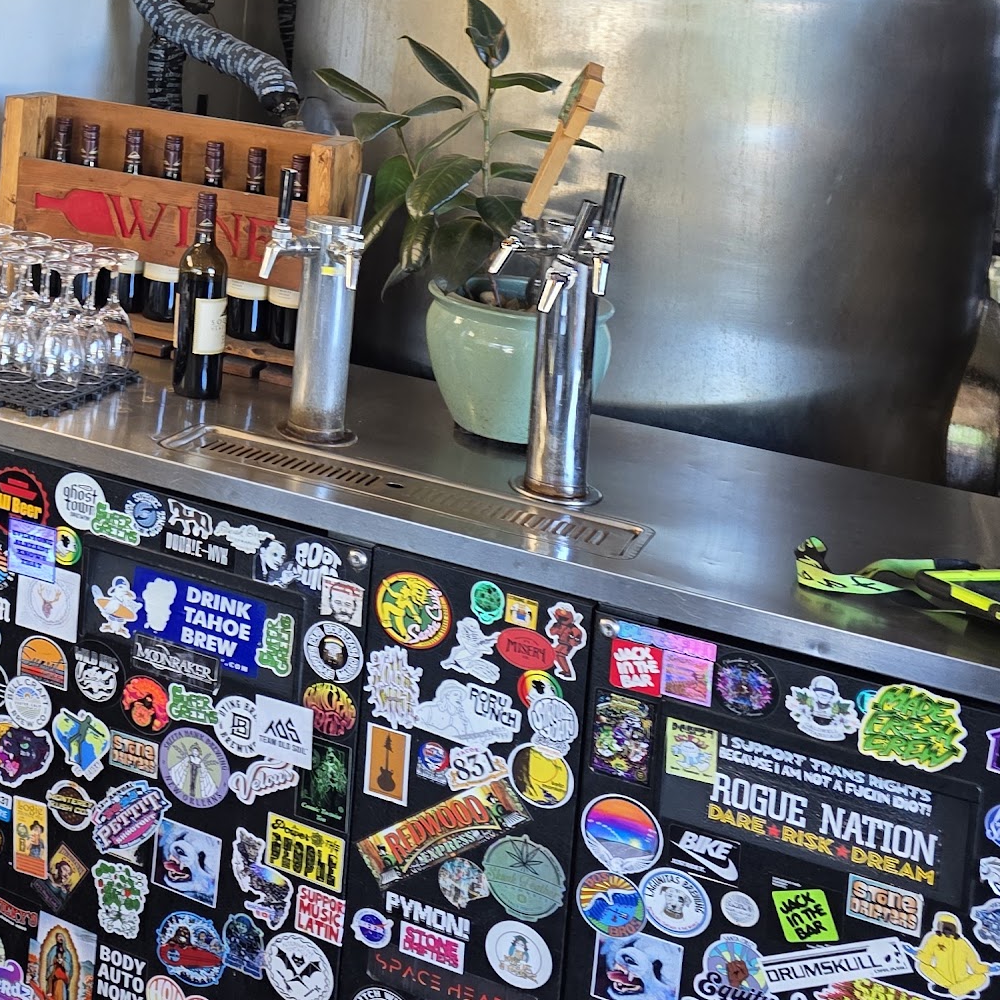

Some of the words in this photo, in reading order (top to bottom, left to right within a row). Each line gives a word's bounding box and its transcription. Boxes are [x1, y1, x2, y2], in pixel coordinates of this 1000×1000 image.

[104, 194, 278, 263] WINE
[11, 497, 42, 520] Beer
[64, 484, 97, 504] ghost
[13, 539, 50, 554] ALREADY
[17, 549, 47, 562] KNOWS
[21, 558, 42, 569] THAT
[186, 586, 252, 620] DRINK
[183, 607, 251, 641] TAHOE
[181, 626, 238, 657] BREW
[506, 639, 546, 665] MISERY
[613, 646, 654, 661] JACK
[136, 642, 217, 681] MOONRAKER
[616, 661, 635, 674] IN
[633, 660, 660, 674] THE
[620, 673, 655, 689] BAR
[475, 702, 516, 728] LUNCH
[872, 685, 956, 722] MADE
[278, 740, 291, 750] OLD
[863, 732, 961, 768] CREW
[453, 751, 497, 781] 831
[719, 747, 773, 773] BECAUSE
[781, 767, 803, 781] AM
[803, 770, 832, 788] NOT
[833, 779, 844, 792] A
[721, 734, 728, 746] I
[731, 736, 807, 768] SUPPORT
[808, 756, 865, 783] TRANS
[869, 774, 933, 801] RIGHTS
[182, 790, 223, 807] ORLEANS
[97, 791, 162, 848] PETTIT
[385, 795, 489, 862] REDWOOD
[710, 772, 809, 829] ROGUE
[818, 802, 938, 867] NATION
[678, 830, 734, 861] BIKE
[707, 803, 767, 836] DARE
[782, 825, 834, 856] RISK
[851, 846, 936, 886] DREAM
[271, 832, 337, 887] PEOPLE
[300, 902, 341, 927] MUSIC
[386, 892, 470, 941] PYMON!
[780, 892, 816, 915] JACK
[786, 912, 802, 928] IN
[801, 904, 827, 922] THE
[298, 917, 340, 942] LATIN
[404, 926, 458, 955] STONE
[608, 918, 641, 936] BROS
[794, 921, 828, 941] BAR
[99, 944, 146, 976] BODY
[375, 953, 441, 991] SPACE
[766, 955, 882, 982] DRUMSKULL
[97, 962, 144, 994] AUTO
